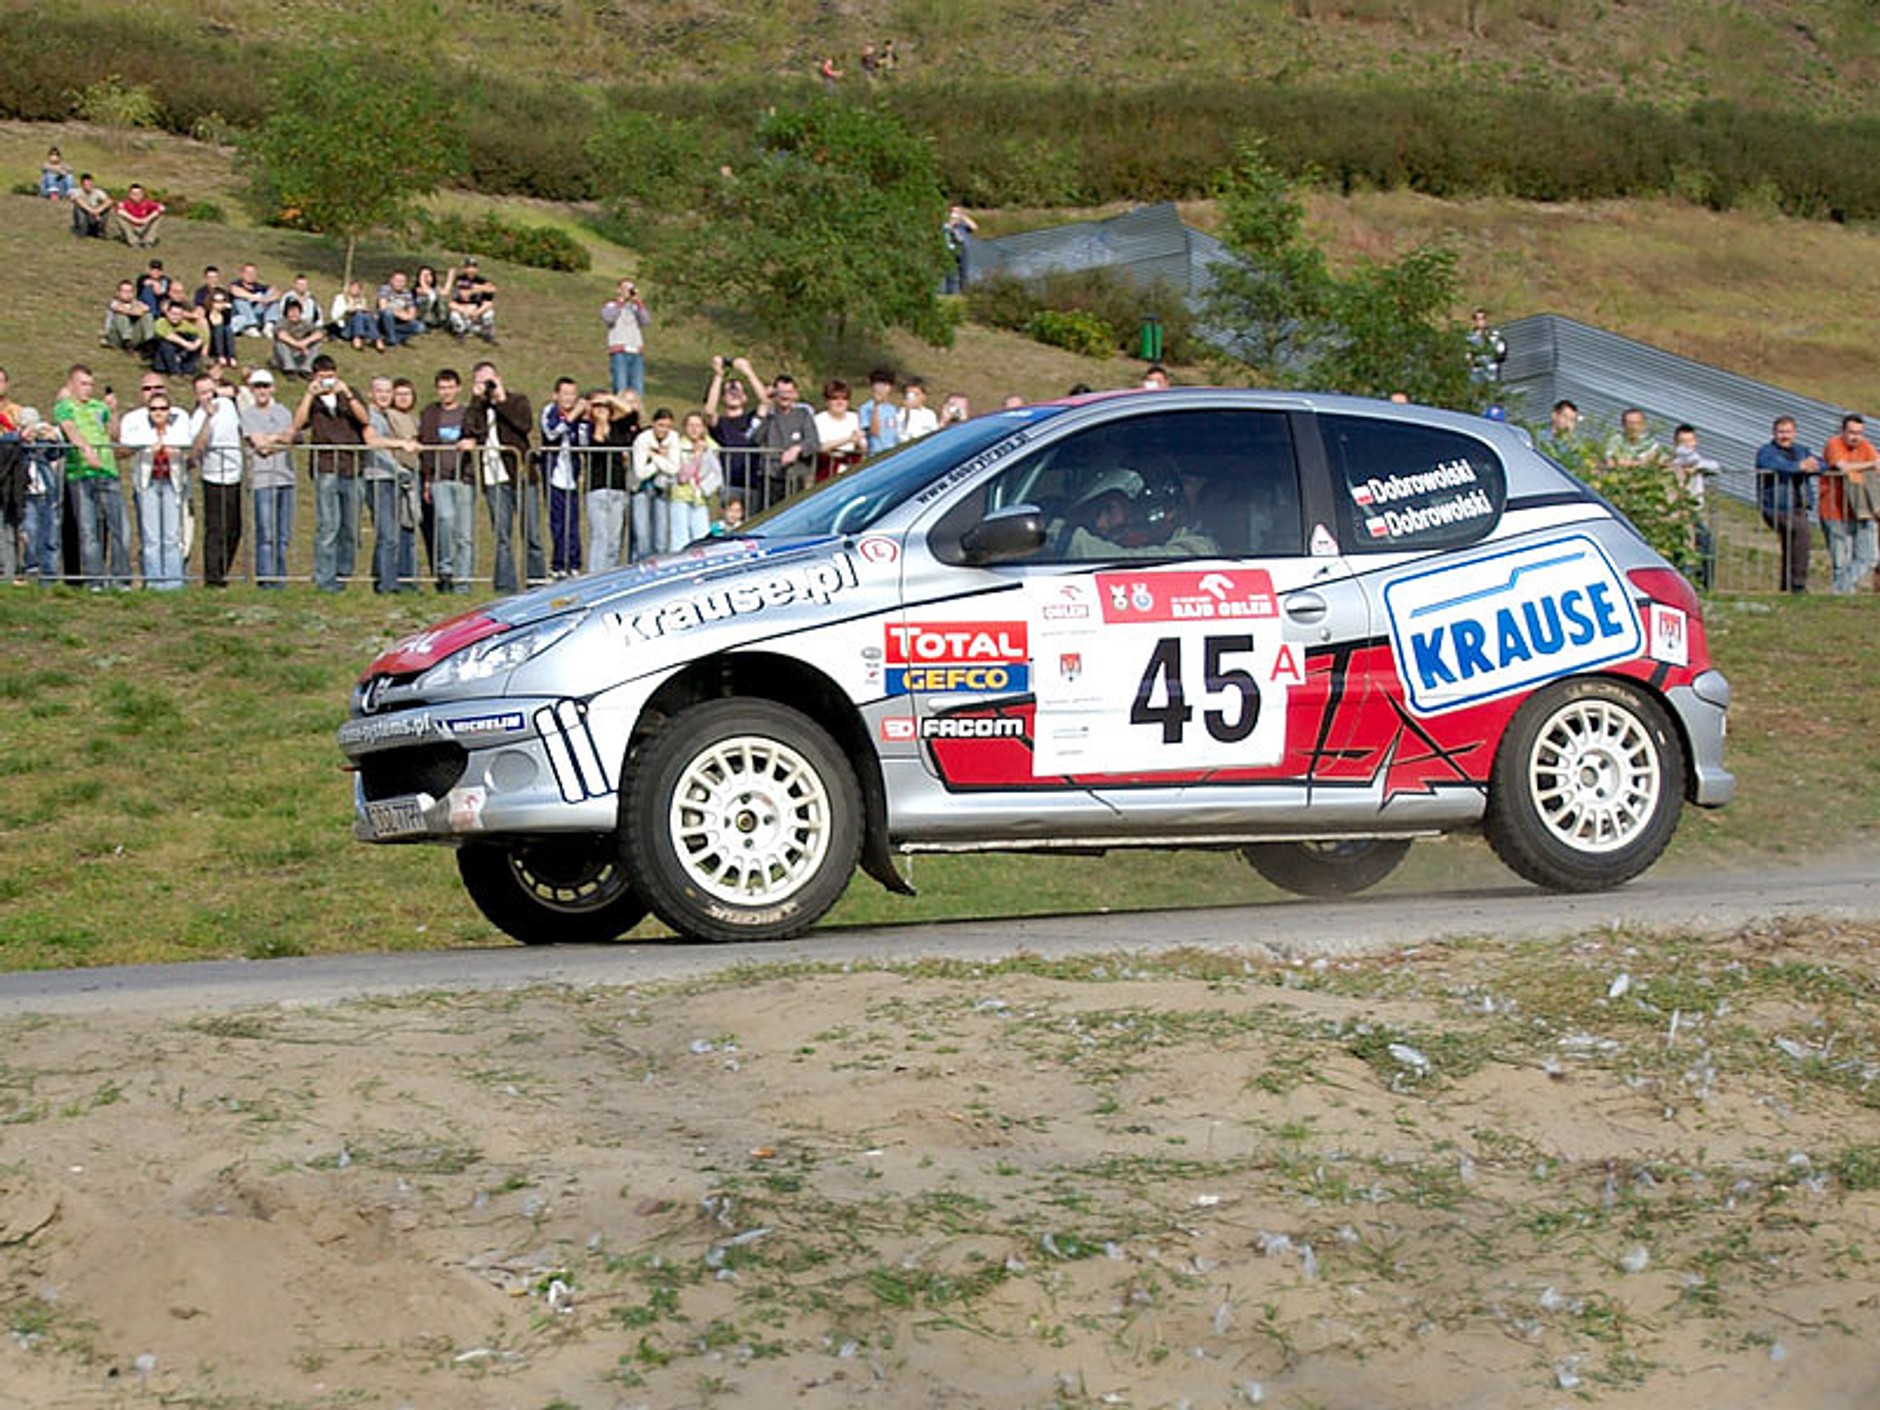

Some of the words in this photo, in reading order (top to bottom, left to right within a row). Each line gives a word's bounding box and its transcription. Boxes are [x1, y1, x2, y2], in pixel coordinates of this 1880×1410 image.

[1368, 458, 1476, 503] Dobrowolski
[1384, 489, 1493, 536] Dobrowolski
[602, 551, 859, 645] krause.pl
[889, 627, 1024, 659] TOTAL
[1410, 580, 1624, 690] KRAUSE
[902, 668, 1009, 690] GEFCO
[1130, 634, 1262, 744] 45
[1269, 643, 1301, 682] A
[923, 719, 1025, 737] FACOM
